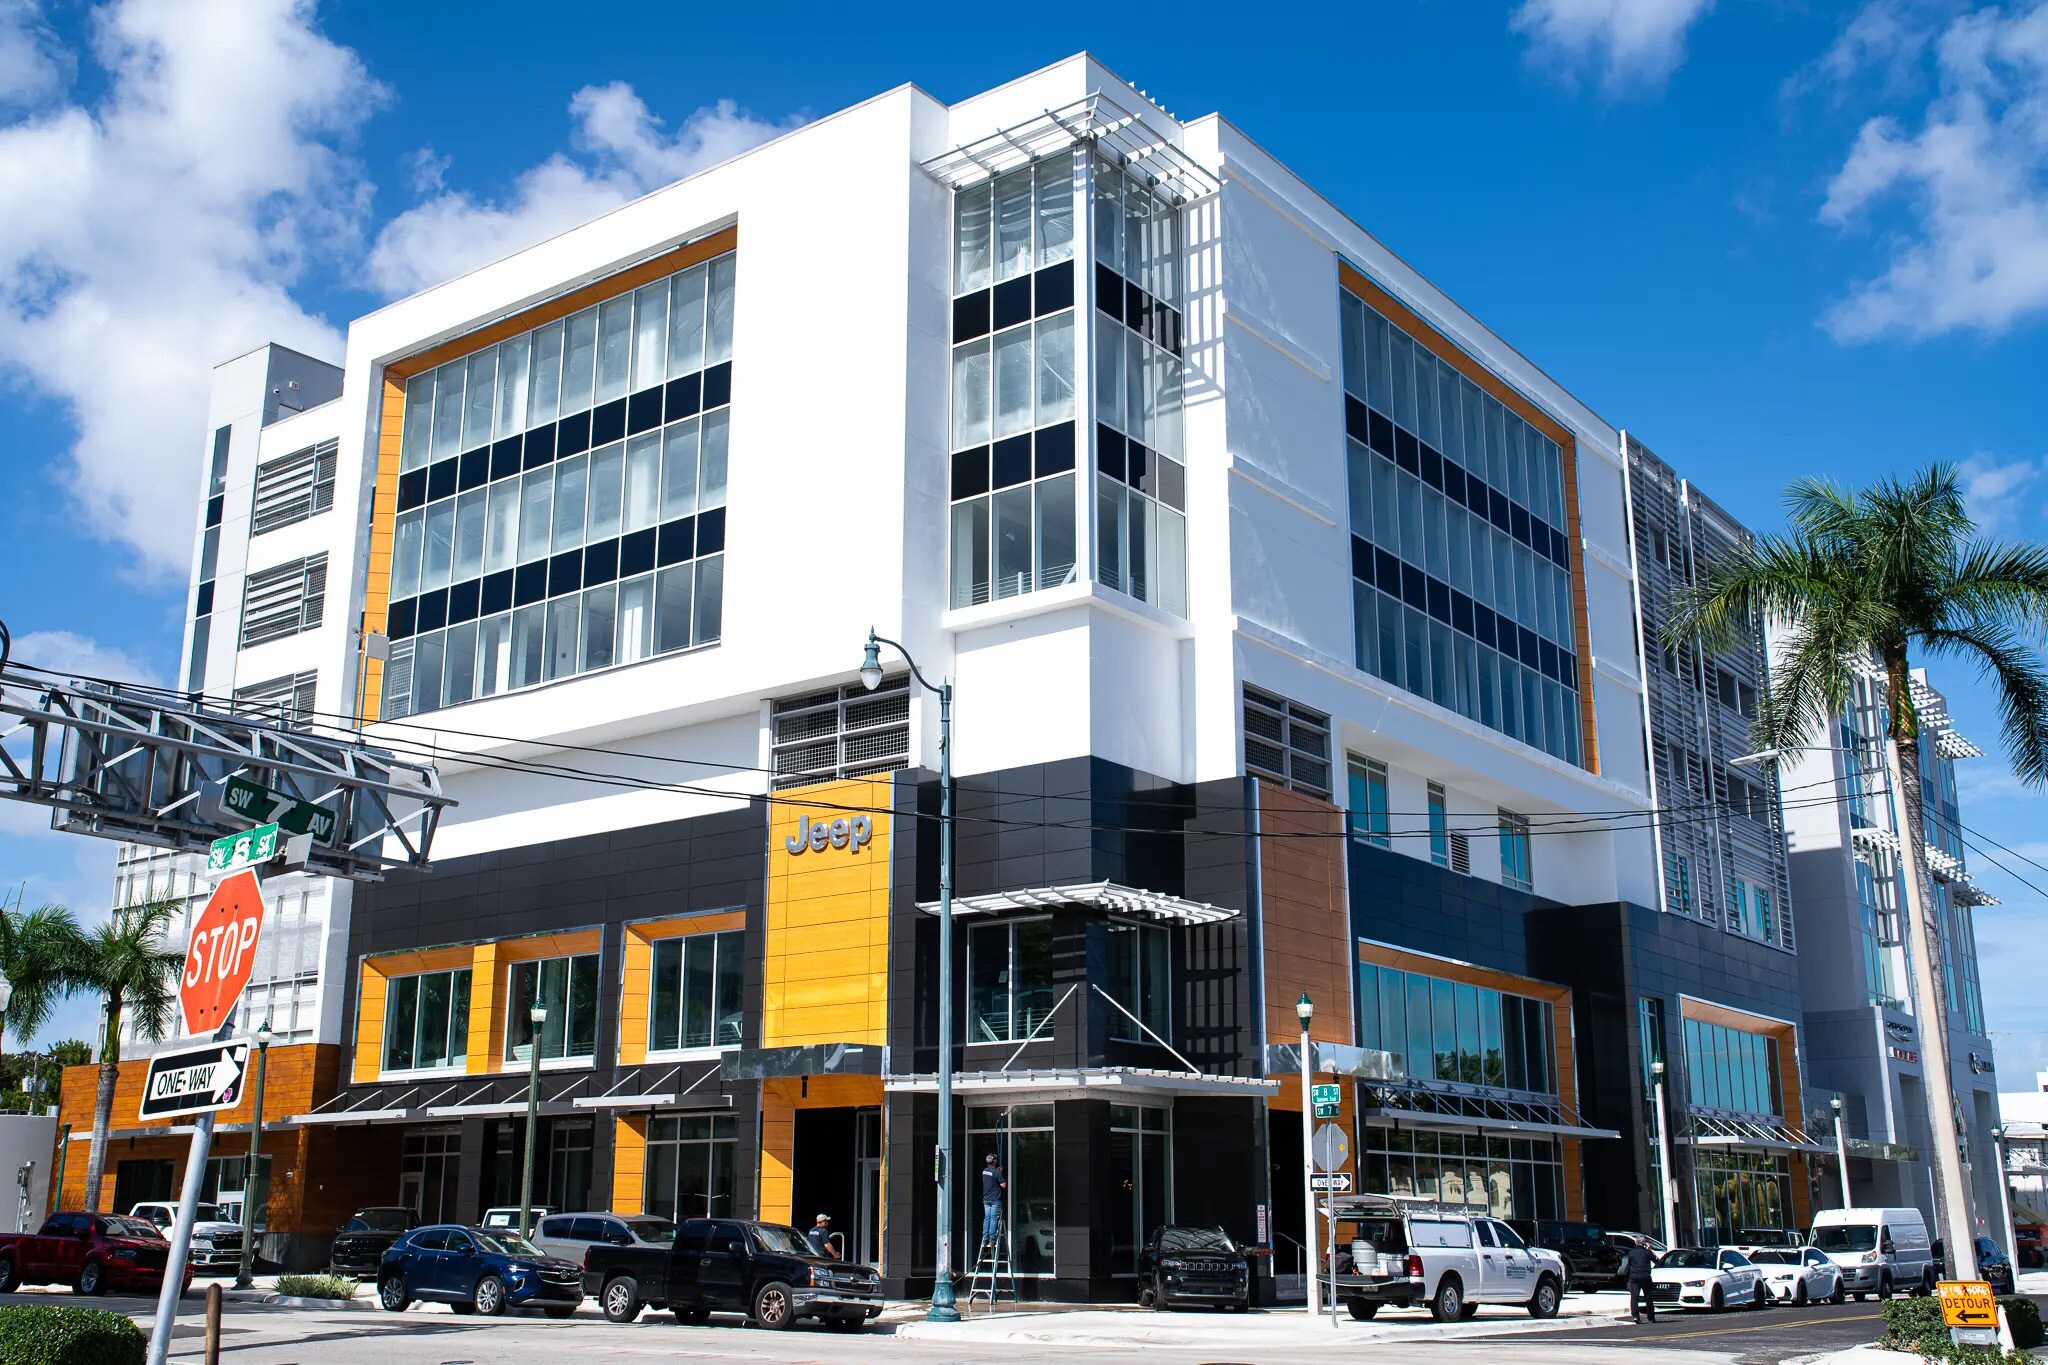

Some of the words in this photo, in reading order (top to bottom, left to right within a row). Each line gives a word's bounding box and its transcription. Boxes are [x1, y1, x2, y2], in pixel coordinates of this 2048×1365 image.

[229, 787, 253, 809] SW
[265, 791, 297, 823] 7
[307, 812, 331, 836] AV
[210, 847, 231, 869] SW
[231, 836, 252, 866] 8
[256, 832, 276, 857] ST
[785, 814, 872, 855] Jeep
[186, 916, 258, 988] STOP
[157, 1072, 185, 1097] ONE
[189, 1065, 216, 1091] WAY
[1323, 1087, 1328, 1097] 8
[1327, 1105, 1332, 1116] 7
[1944, 1298, 1991, 1309] DETOUR
